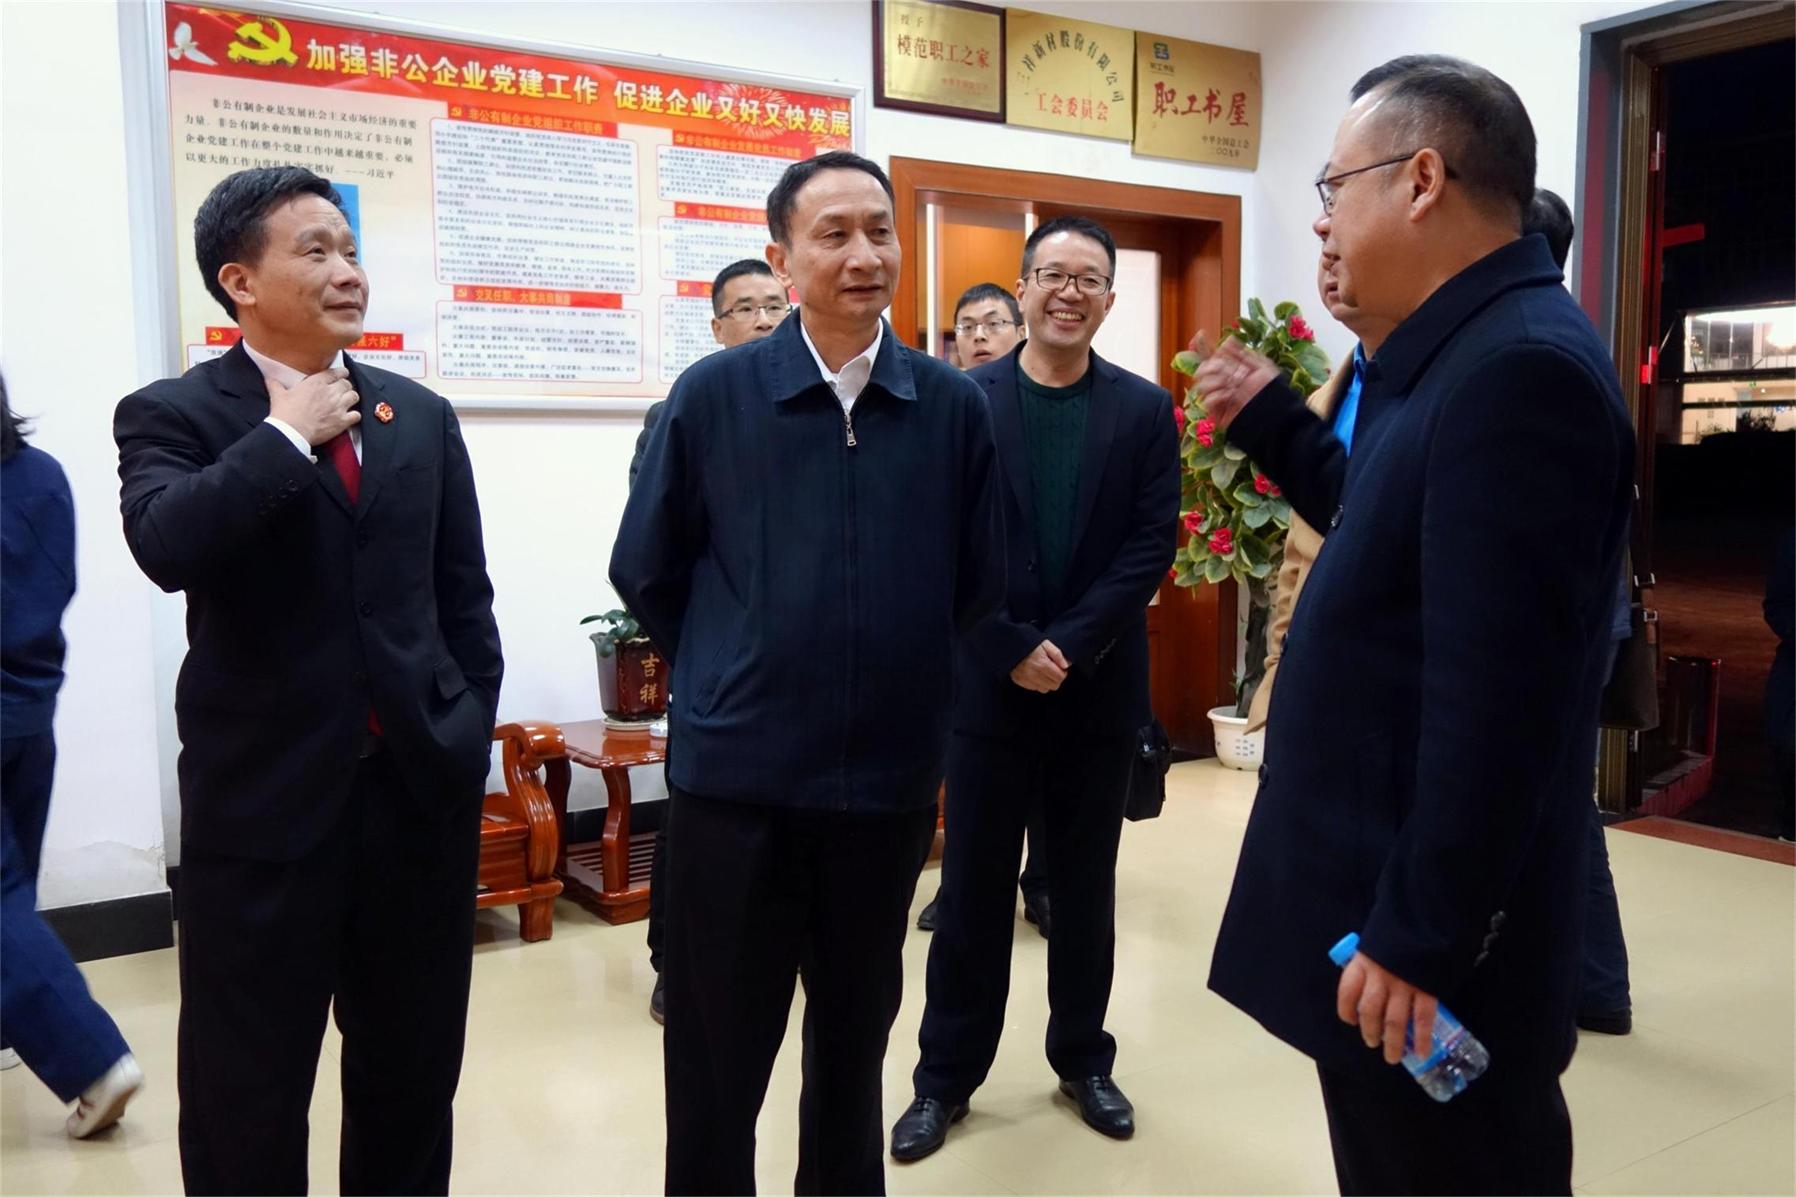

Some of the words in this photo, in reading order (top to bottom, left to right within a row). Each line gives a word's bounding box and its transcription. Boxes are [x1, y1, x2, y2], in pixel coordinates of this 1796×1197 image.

[897, 34, 990, 68] 模范职工之家
[306, 38, 599, 105] 加强非公企业党建工作
[613, 80, 850, 137] 促进企业又好又快发展
[1038, 91, 1109, 122] 工会委员会
[1153, 81, 1249, 127] 职工书屋
[213, 98, 417, 129] 非公有制企业是发展社会主义市场经济的重要
[640, 652, 660, 705] 吉祥
